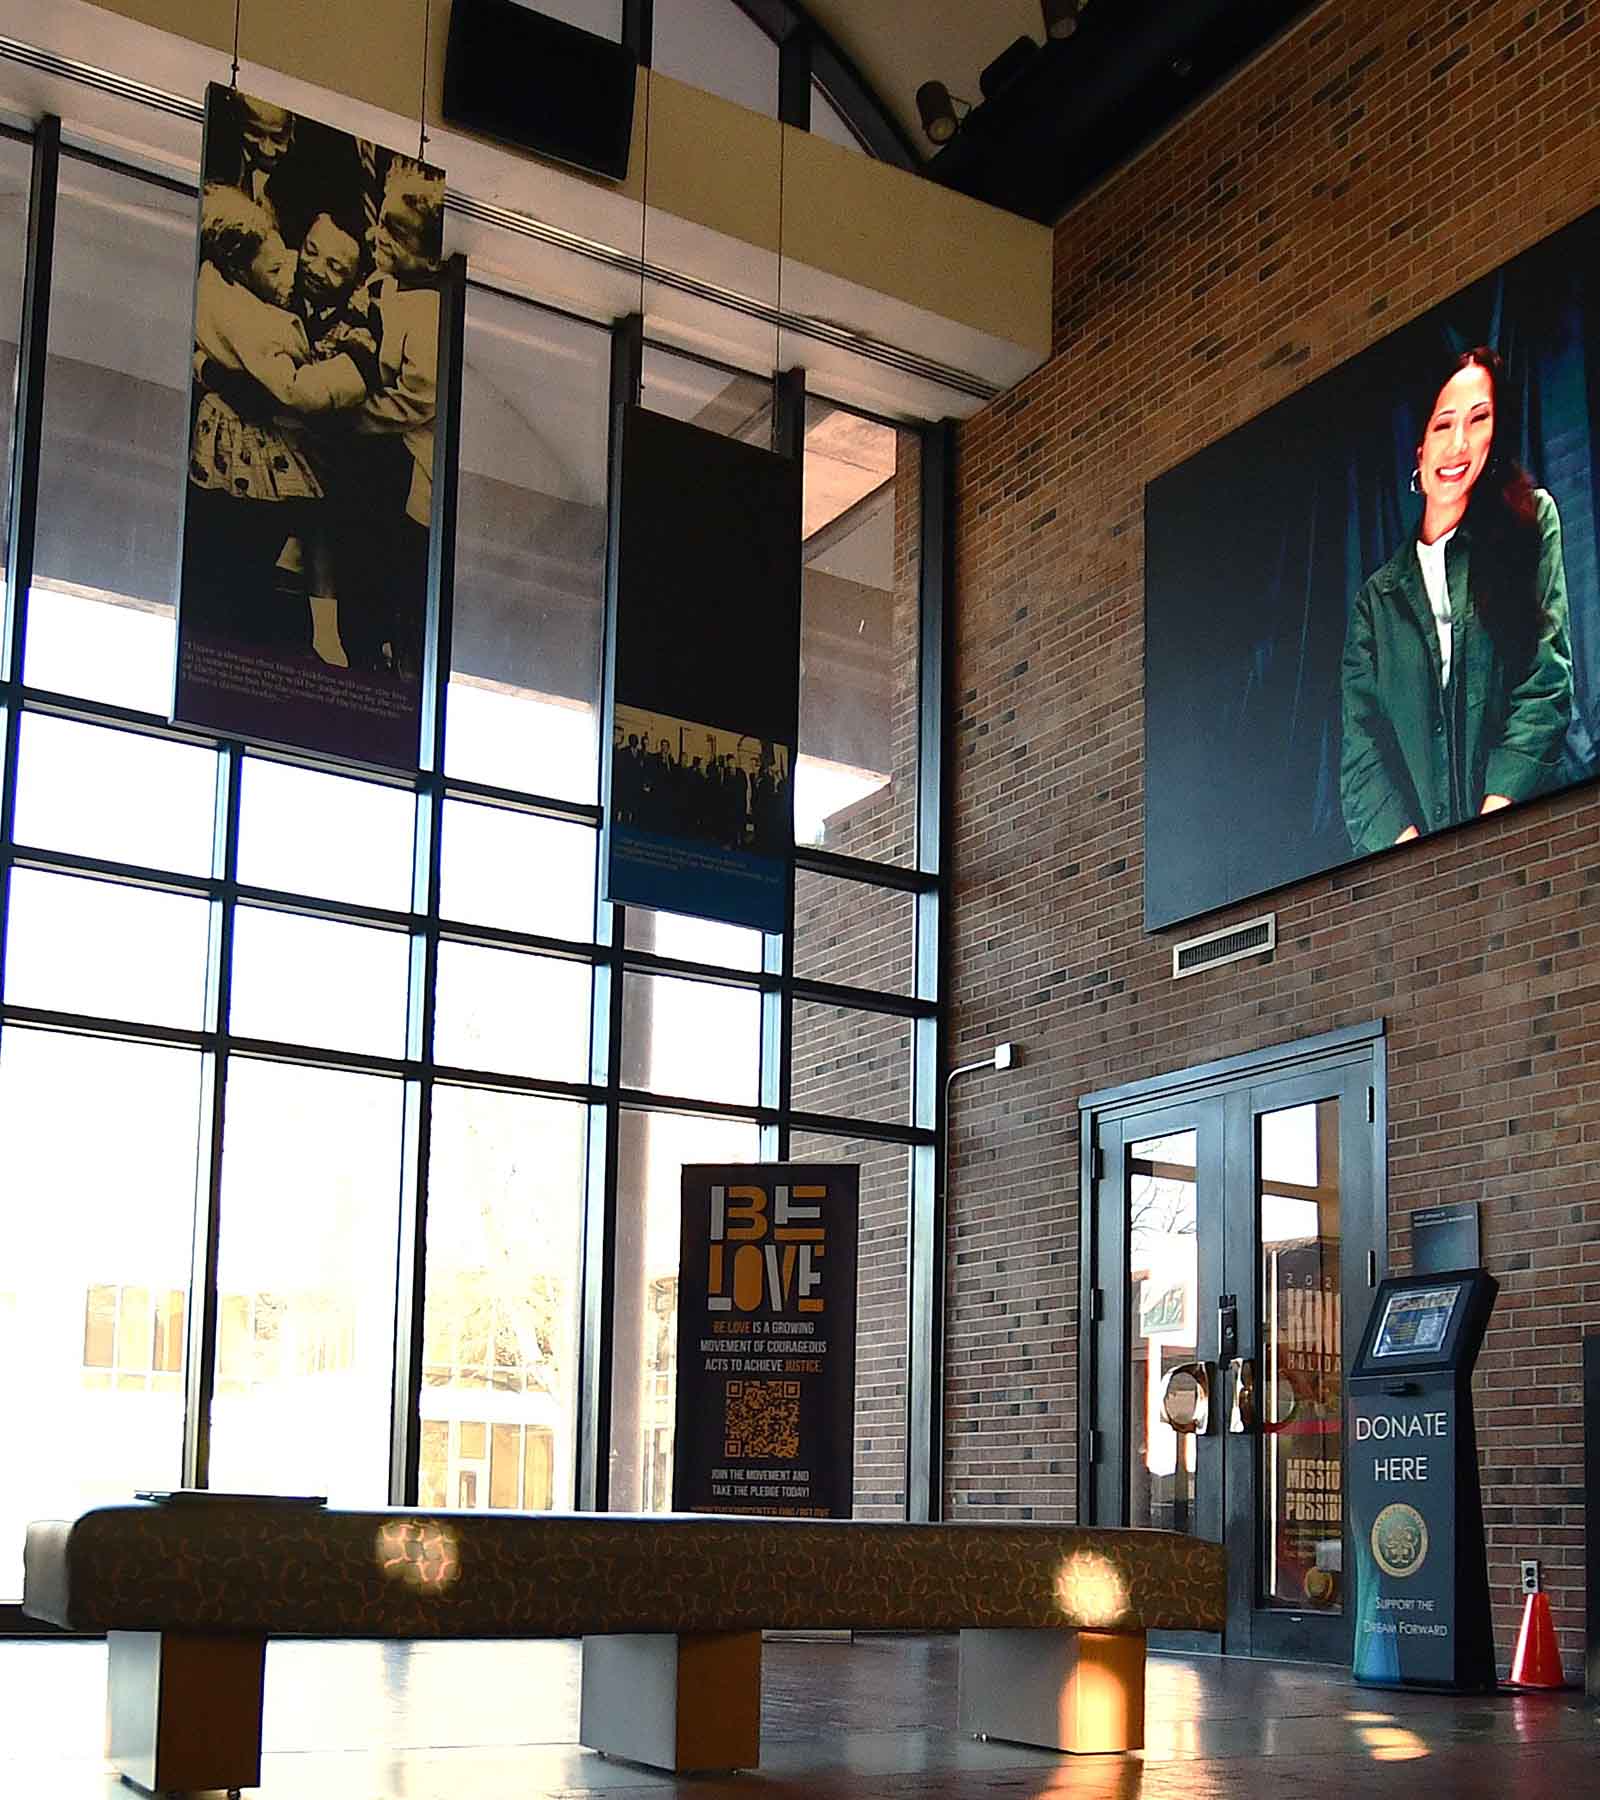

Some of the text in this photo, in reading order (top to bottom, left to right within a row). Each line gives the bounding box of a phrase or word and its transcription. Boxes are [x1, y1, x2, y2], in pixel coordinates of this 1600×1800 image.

[711, 1186, 827, 1240] BE
[708, 1245, 825, 1312] LOVE
[712, 1321, 815, 1335] BE LOVE IS A GROWING
[700, 1339, 828, 1353] MOVEMENT OF COURAGEOUS
[705, 1358, 729, 1371] ACTS
[731, 1359, 743, 1371] TO
[744, 1360, 783, 1372] ACHIEVE
[1356, 1412, 1447, 1440] DONATE
[730, 1469, 745, 1480] THE
[746, 1470, 790, 1481] MOVEMENT
[792, 1470, 809, 1481] AND
[1375, 1457, 1428, 1481] HERE
[712, 1485, 731, 1496] TAKE
[734, 1485, 748, 1497] THE
[750, 1486, 779, 1497] PLEDGE
